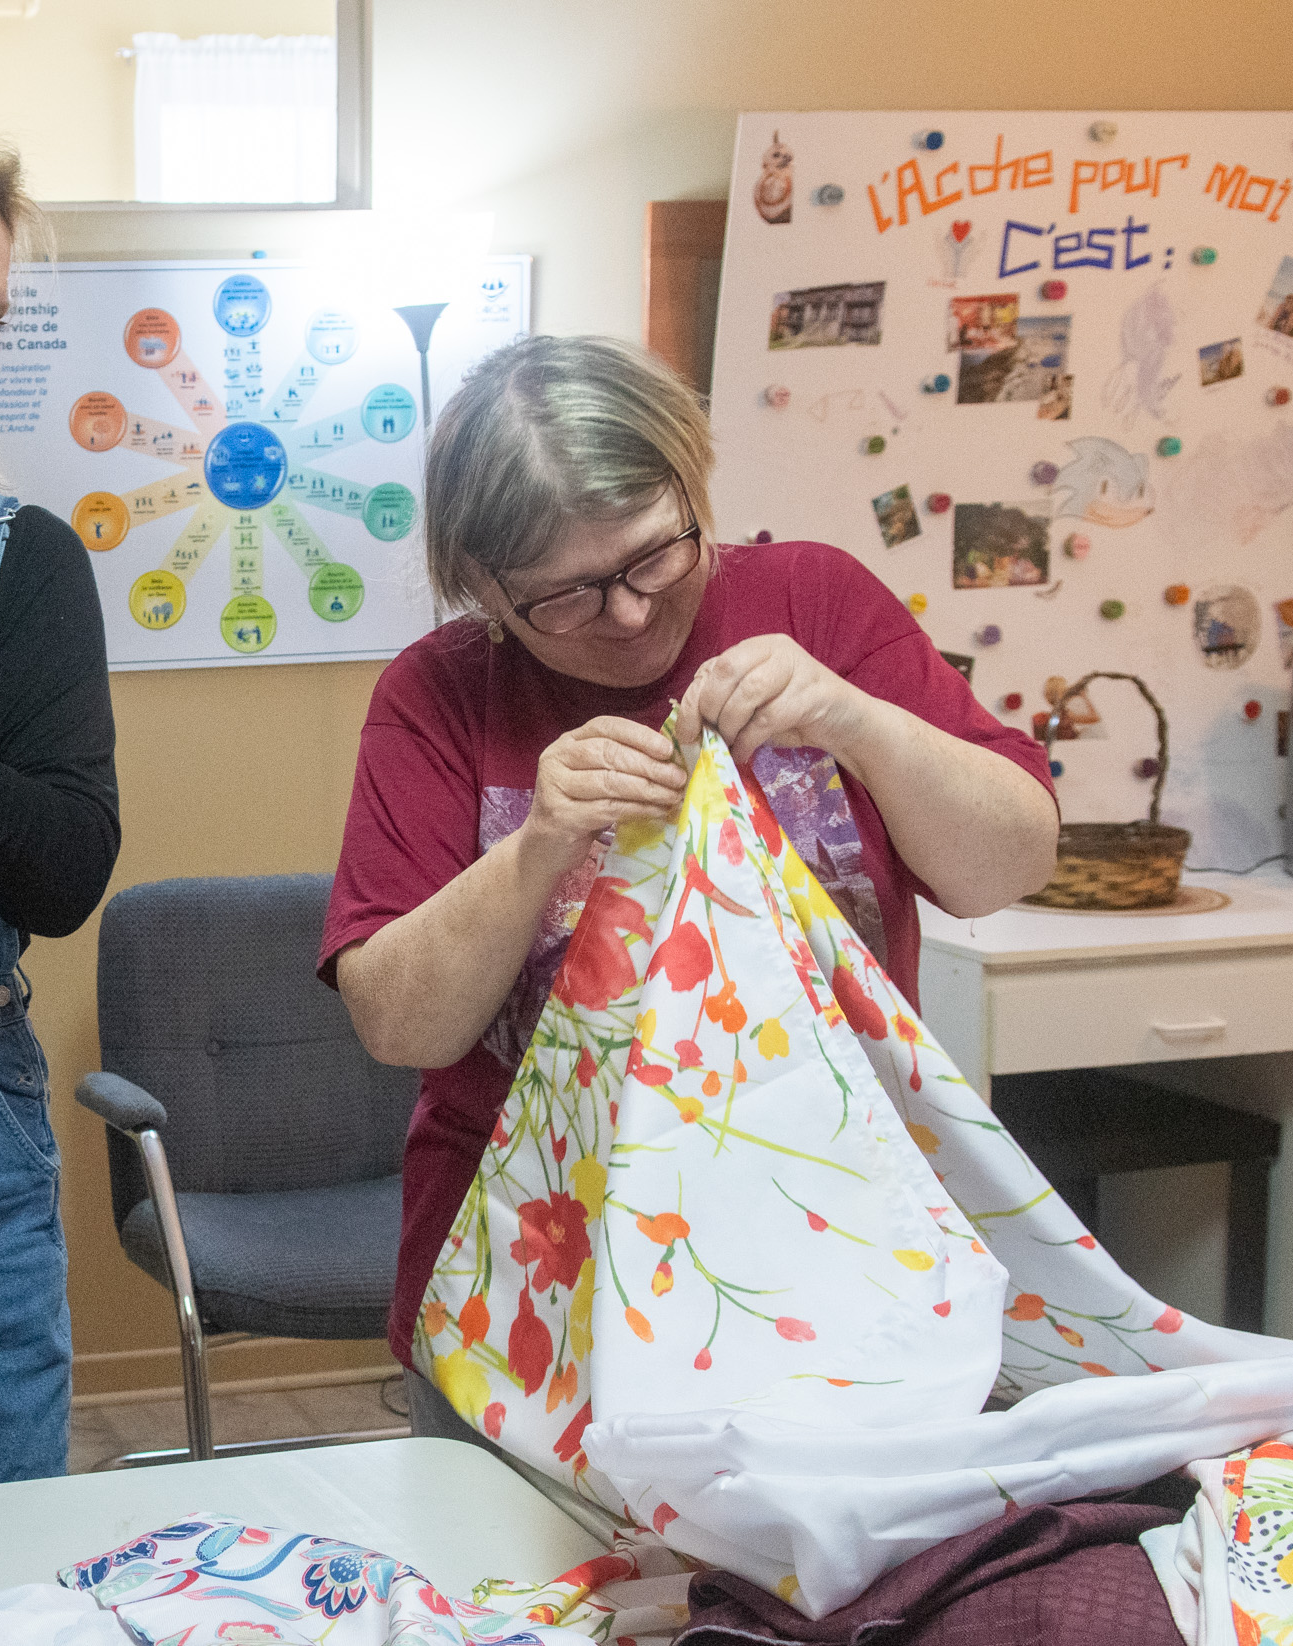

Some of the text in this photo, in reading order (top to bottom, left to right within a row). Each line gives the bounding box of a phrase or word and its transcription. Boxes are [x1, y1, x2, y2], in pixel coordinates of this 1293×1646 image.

[1068, 152, 1191, 215] pour
[41, 320, 58, 332] de
[17, 338, 67, 350] Canada
